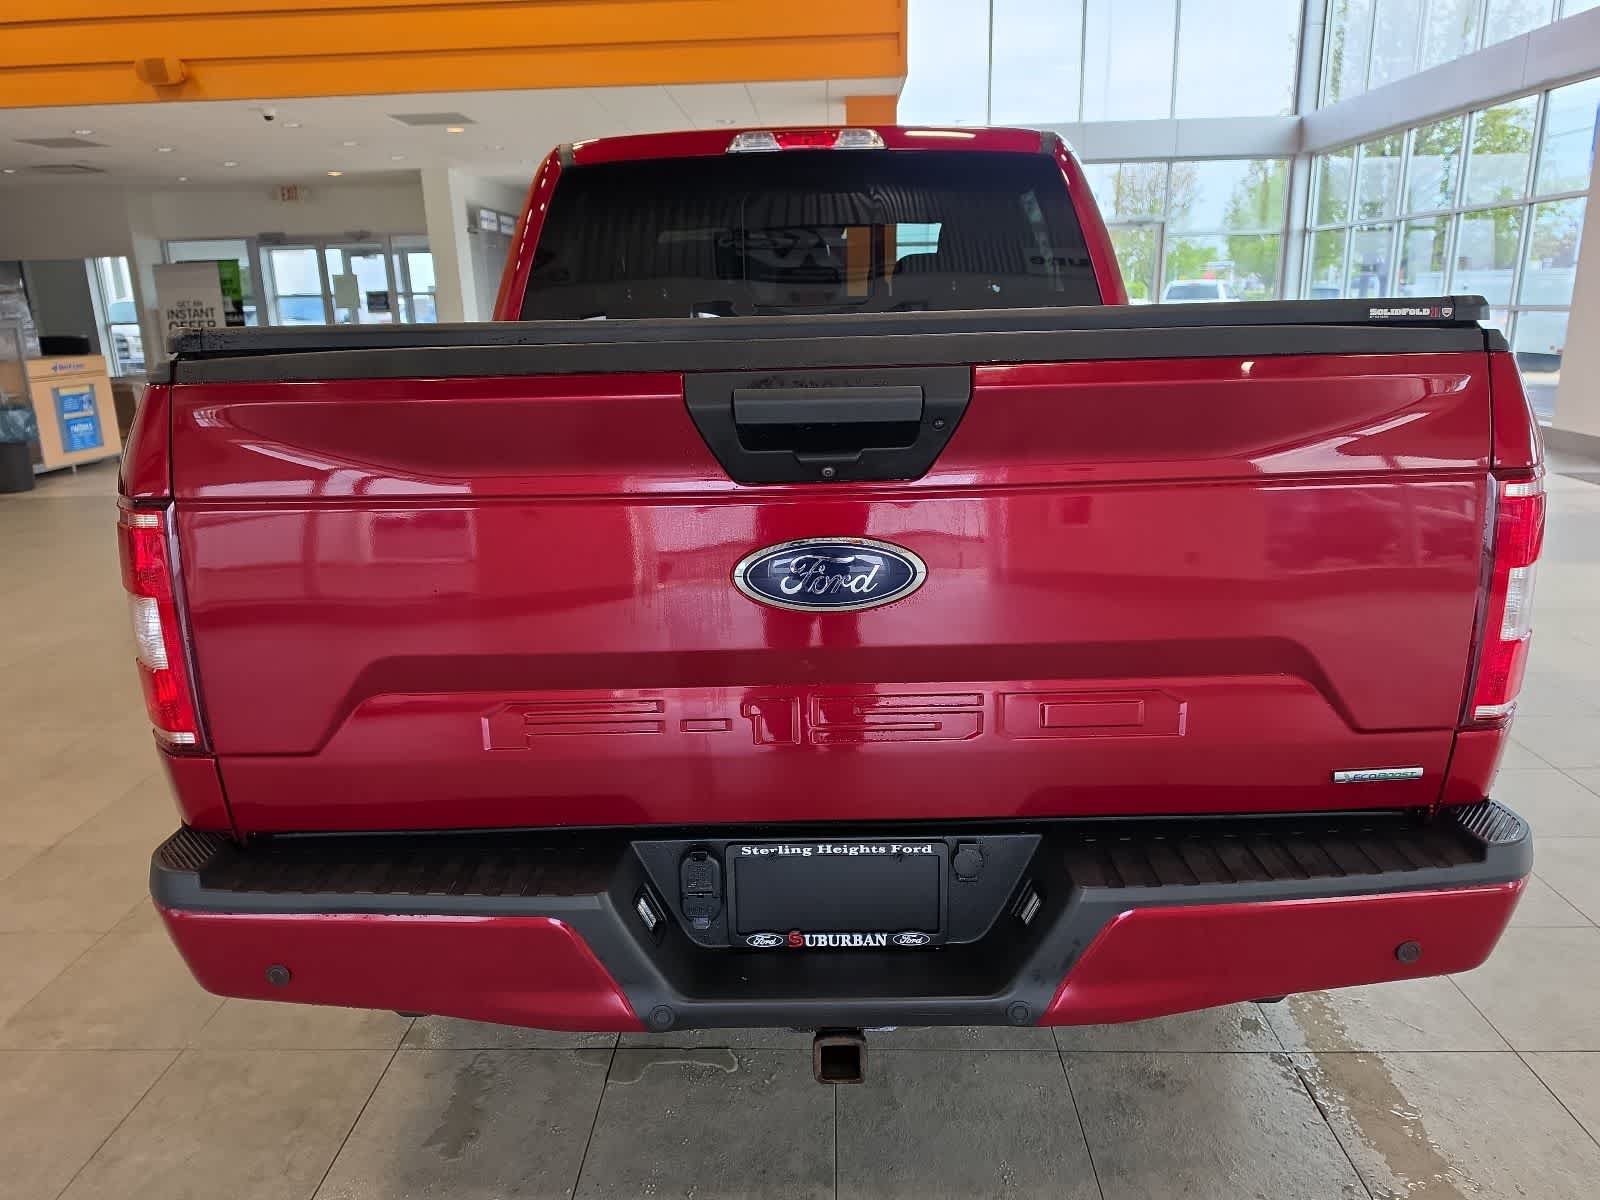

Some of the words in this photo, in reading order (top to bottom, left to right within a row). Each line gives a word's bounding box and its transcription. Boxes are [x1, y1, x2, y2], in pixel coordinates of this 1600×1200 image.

[167, 308, 215, 320] INSTANT
[780, 554, 881, 596] Ford
[480, 690, 1189, 752] F-150
[741, 845, 812, 857] Sterling
[816, 844, 886, 856] Heights
[891, 844, 932, 854] Ford
[753, 935, 777, 945] Ford
[788, 930, 888, 948] SUBURBAN
[899, 934, 923, 944] Ford
